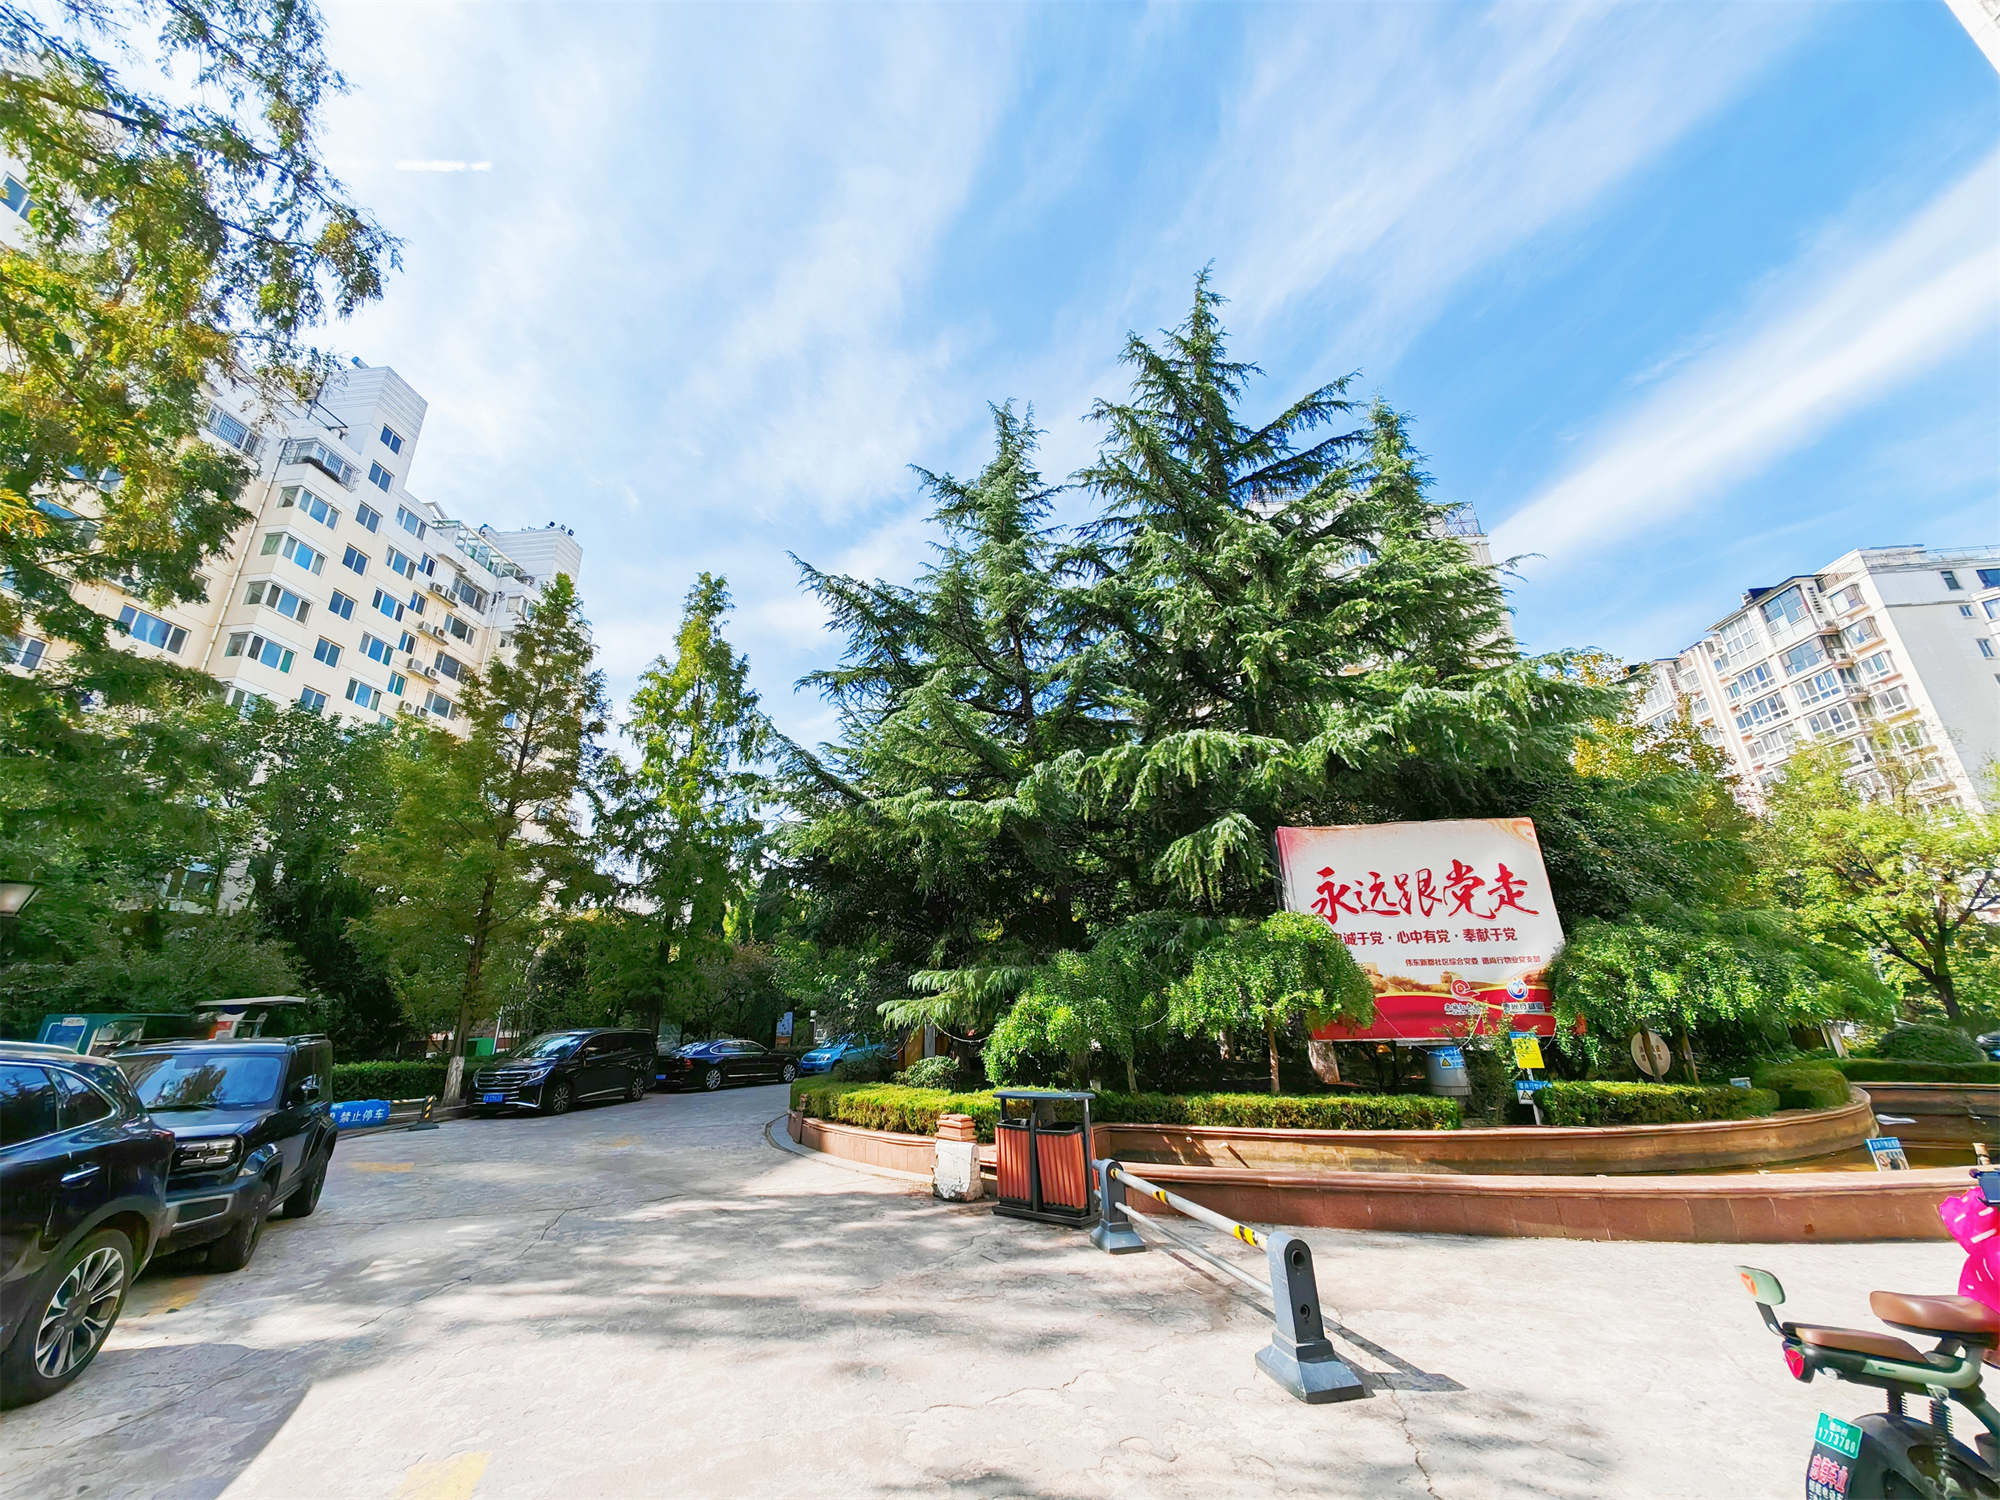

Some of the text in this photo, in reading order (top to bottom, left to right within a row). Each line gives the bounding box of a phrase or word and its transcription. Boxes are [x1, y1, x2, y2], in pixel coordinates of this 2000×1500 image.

[1310, 858, 1540, 925] 永远跟党走
[339, 1108, 385, 1123] 禁止停车
